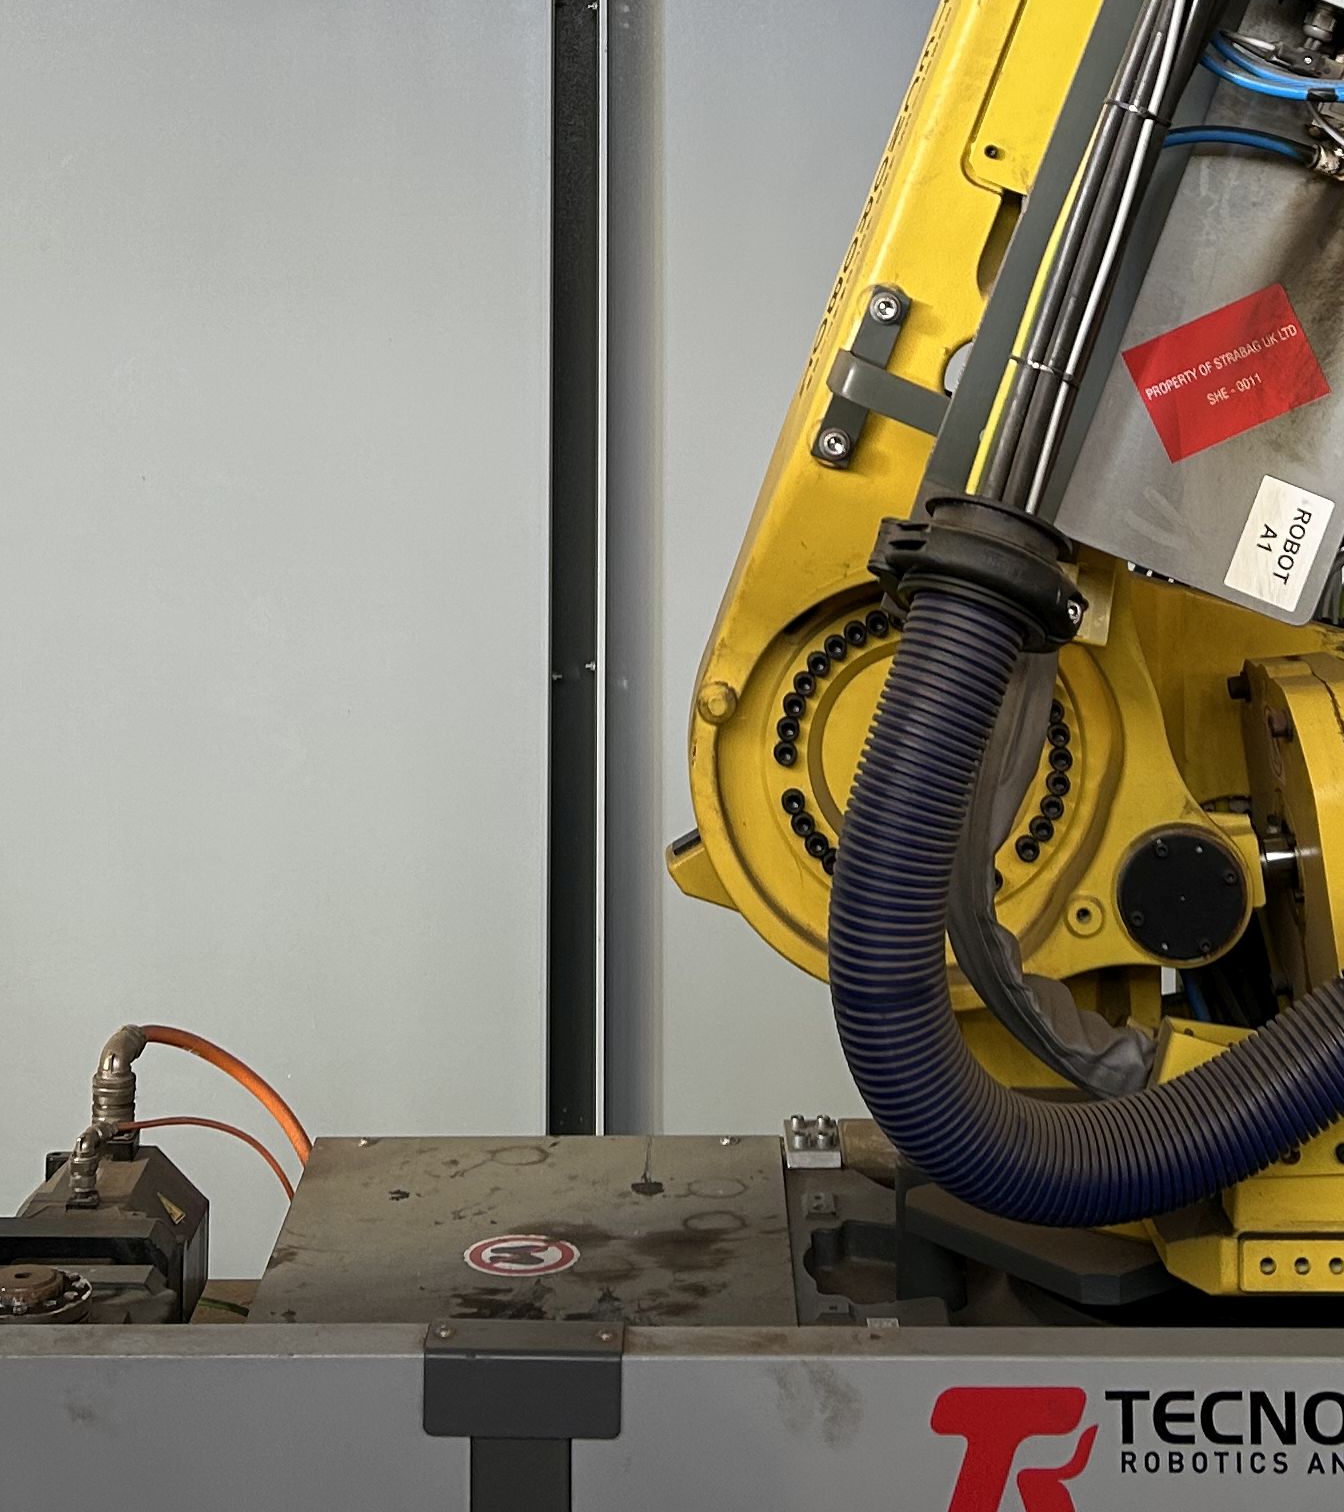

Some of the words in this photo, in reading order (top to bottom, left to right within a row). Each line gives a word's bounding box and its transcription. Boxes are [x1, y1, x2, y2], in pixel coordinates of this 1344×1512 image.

[1145, 367, 1197, 401] PROPERTY
[1198, 361, 1213, 377] OF
[1213, 340, 1261, 370] STRABAG
[1263, 333, 1278, 348] UK
[1279, 324, 1298, 341] LTD
[1206, 386, 1230, 406] SHE
[1256, 524, 1277, 552] A1
[1273, 508, 1312, 585] ROBOT
[1121, 1451, 1288, 1474] ROBOTICS
